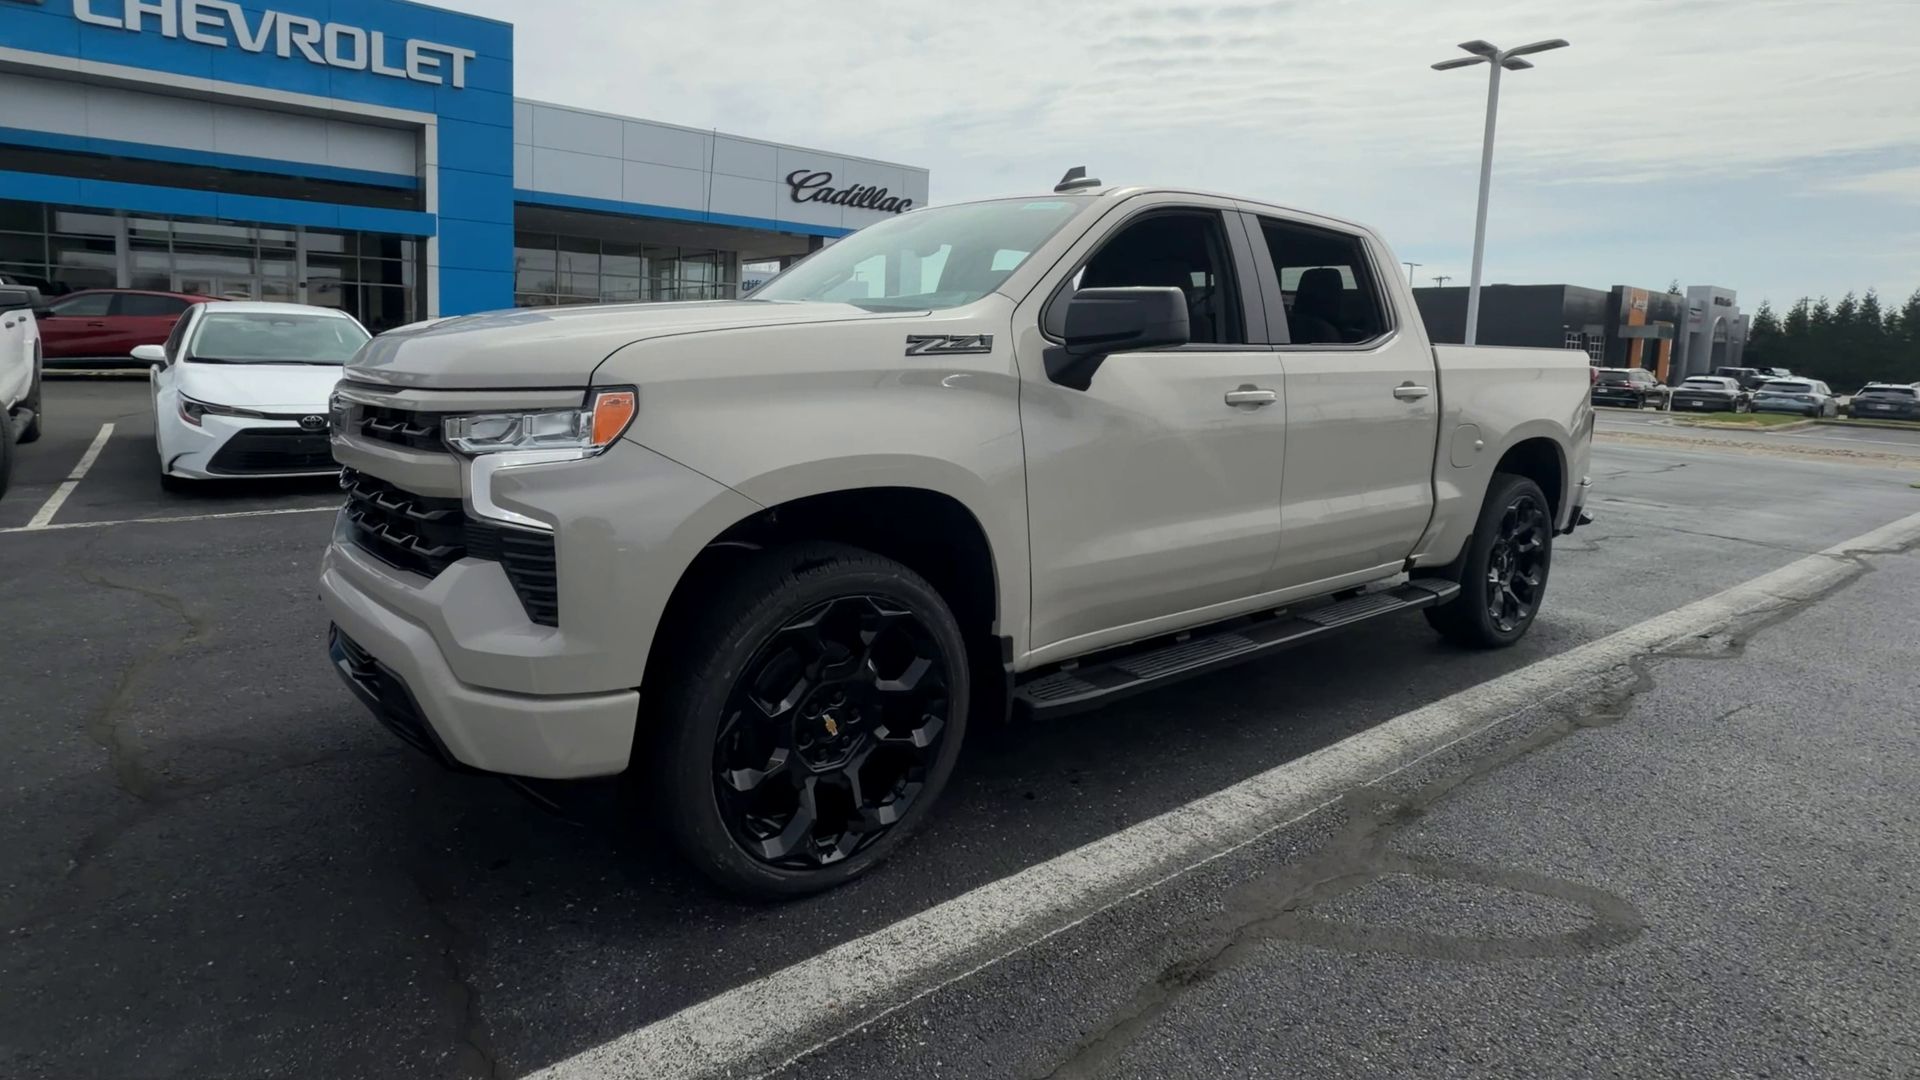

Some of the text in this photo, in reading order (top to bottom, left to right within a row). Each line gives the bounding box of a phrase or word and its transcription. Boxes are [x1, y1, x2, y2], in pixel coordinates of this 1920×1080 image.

[73, 0, 476, 88] CHEVROLET
[786, 169, 913, 214] Cadillac
[905, 334, 994, 356] Z71
